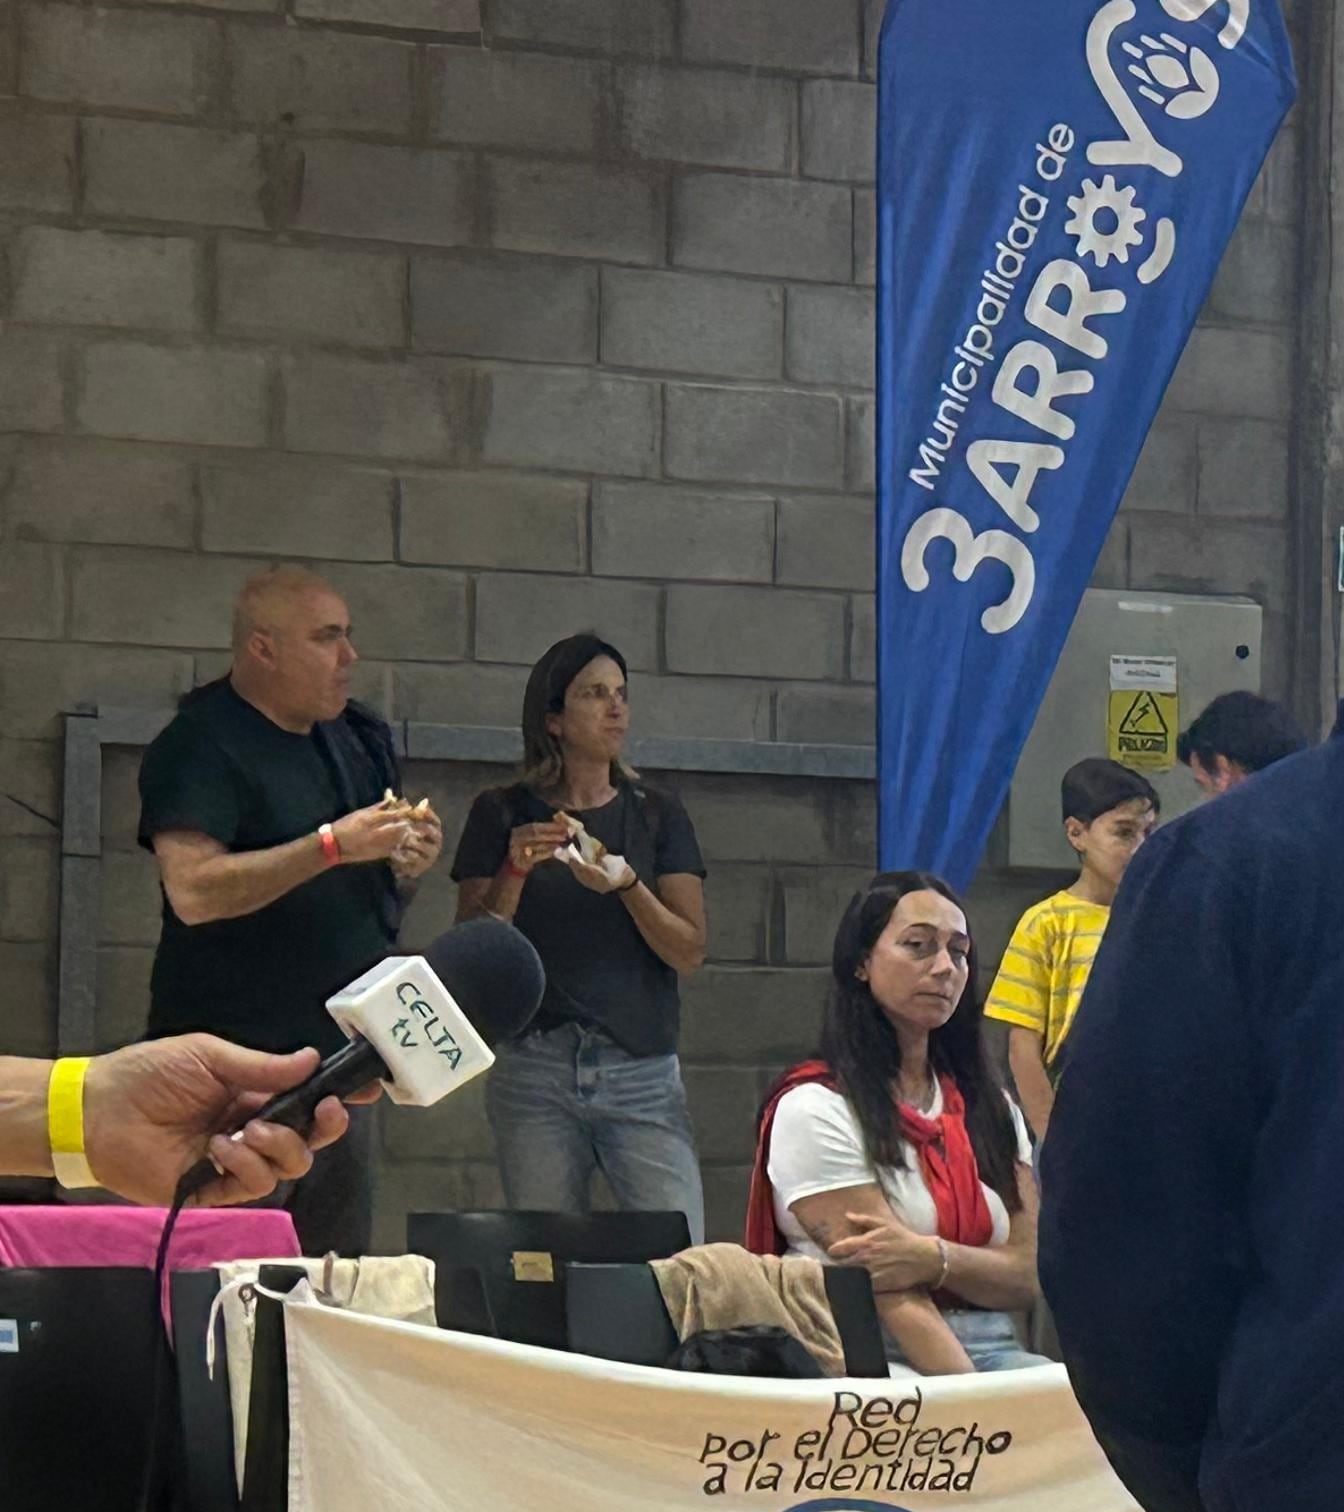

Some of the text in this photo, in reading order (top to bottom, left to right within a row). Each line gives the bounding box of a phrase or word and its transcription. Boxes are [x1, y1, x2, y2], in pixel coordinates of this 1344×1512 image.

[908, 121, 1076, 491] Municipalidad de
[396, 982, 462, 1071] CELTA
[829, 1385, 923, 1429] Red
[793, 1427, 834, 1462] el
[840, 1422, 1014, 1461] Derecho
[702, 1462, 728, 1496] a
[744, 1459, 785, 1493] la
